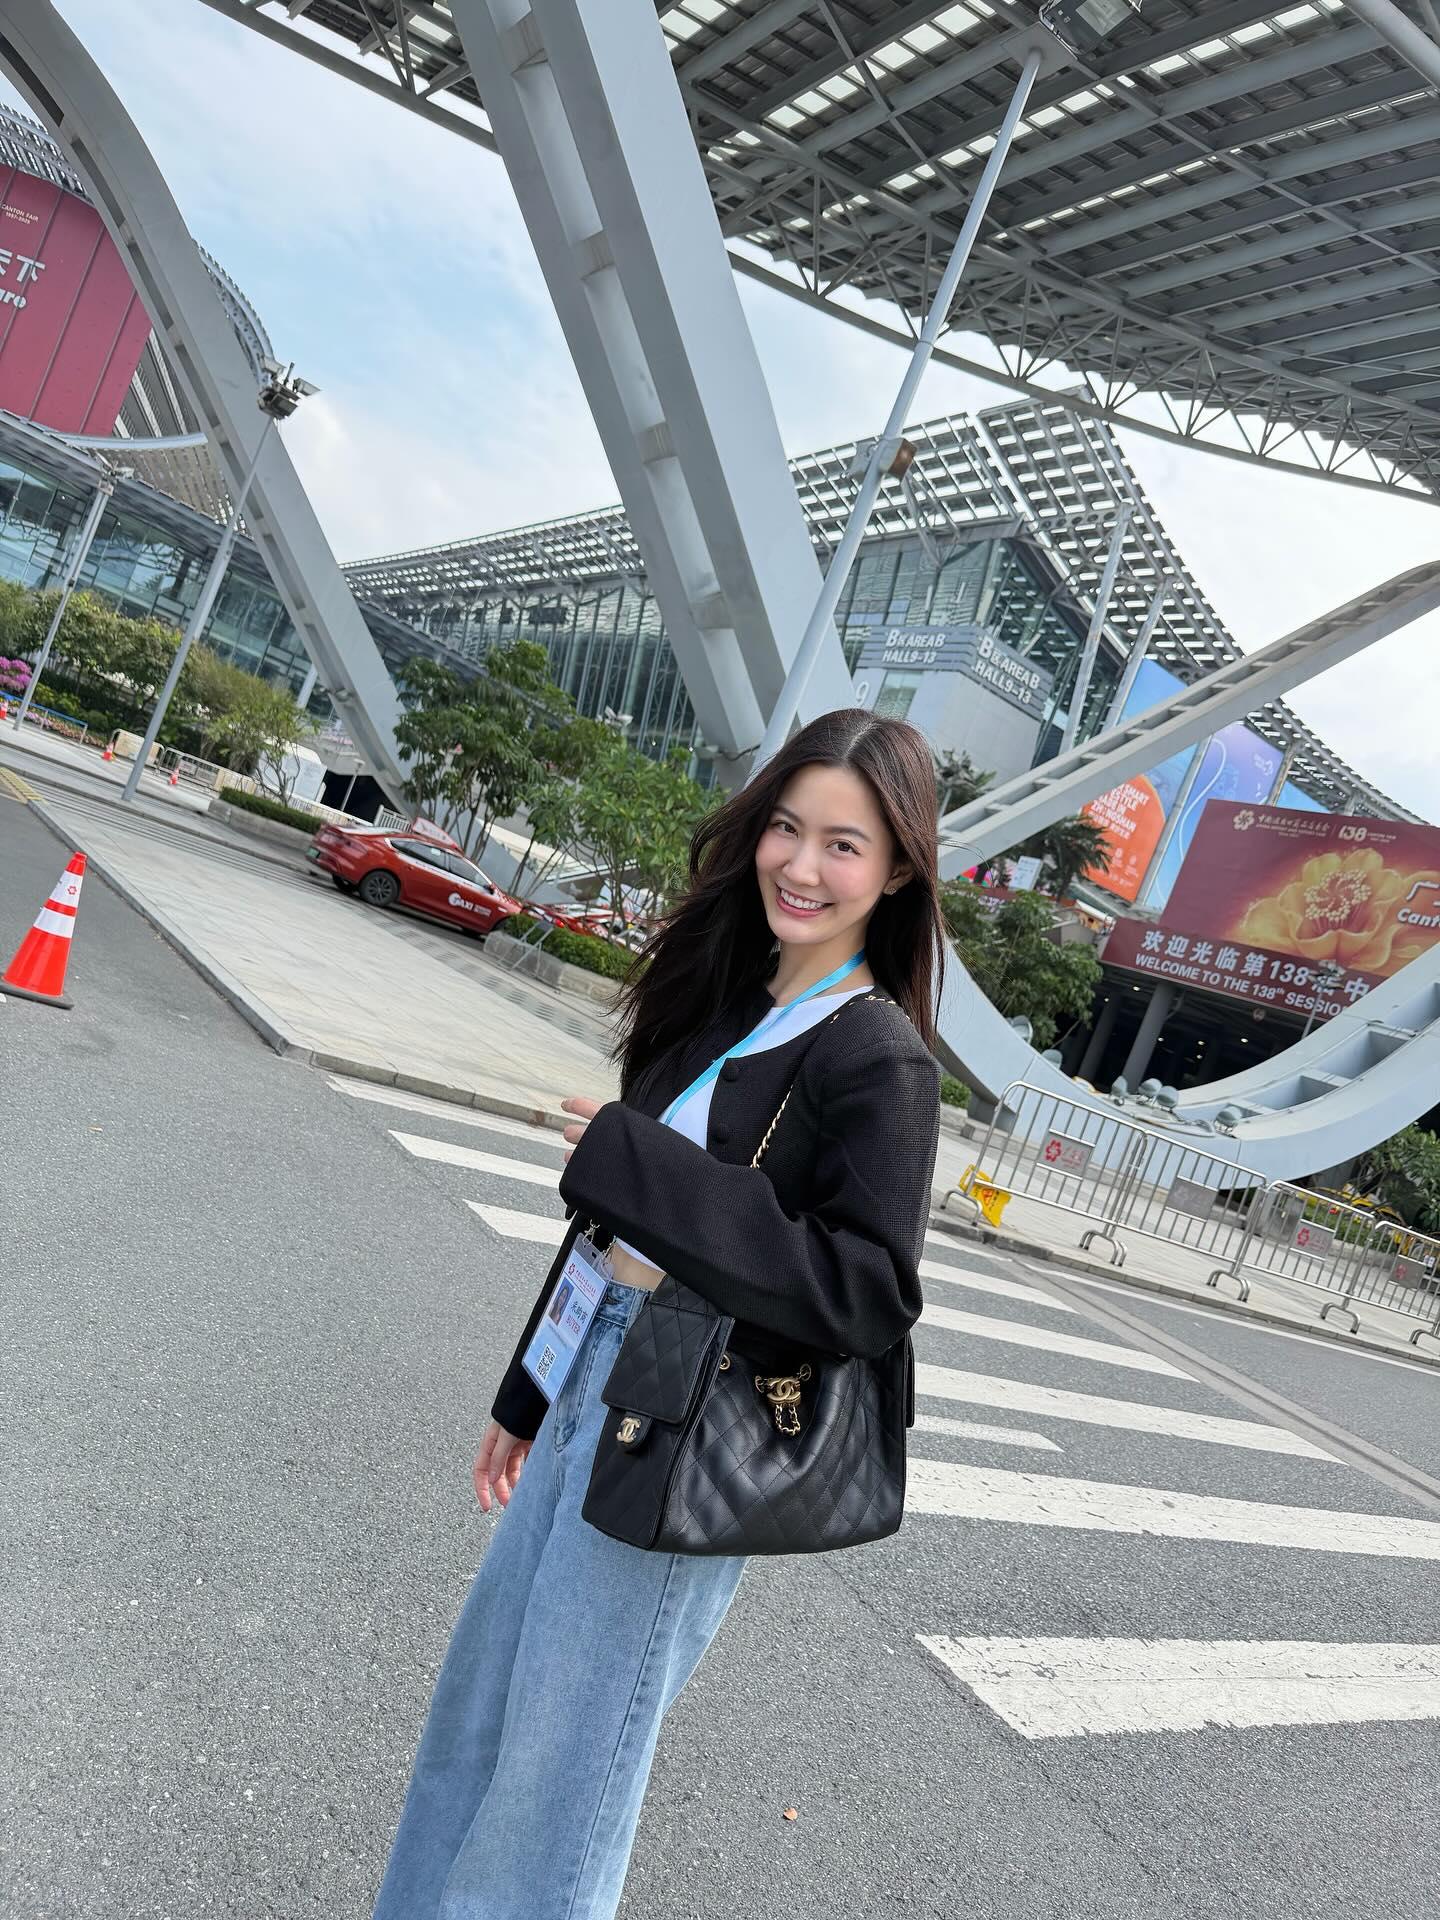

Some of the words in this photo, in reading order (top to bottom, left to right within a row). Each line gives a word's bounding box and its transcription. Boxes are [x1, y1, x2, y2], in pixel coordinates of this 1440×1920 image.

[1338, 825, 1368, 842] 138
[1398, 908, 1440, 928] Cant
[1135, 953, 1201, 980] WELCOME
[1202, 970, 1221, 985] TO
[1223, 975, 1251, 993] THE
[1284, 991, 1345, 1016] SESSIO
